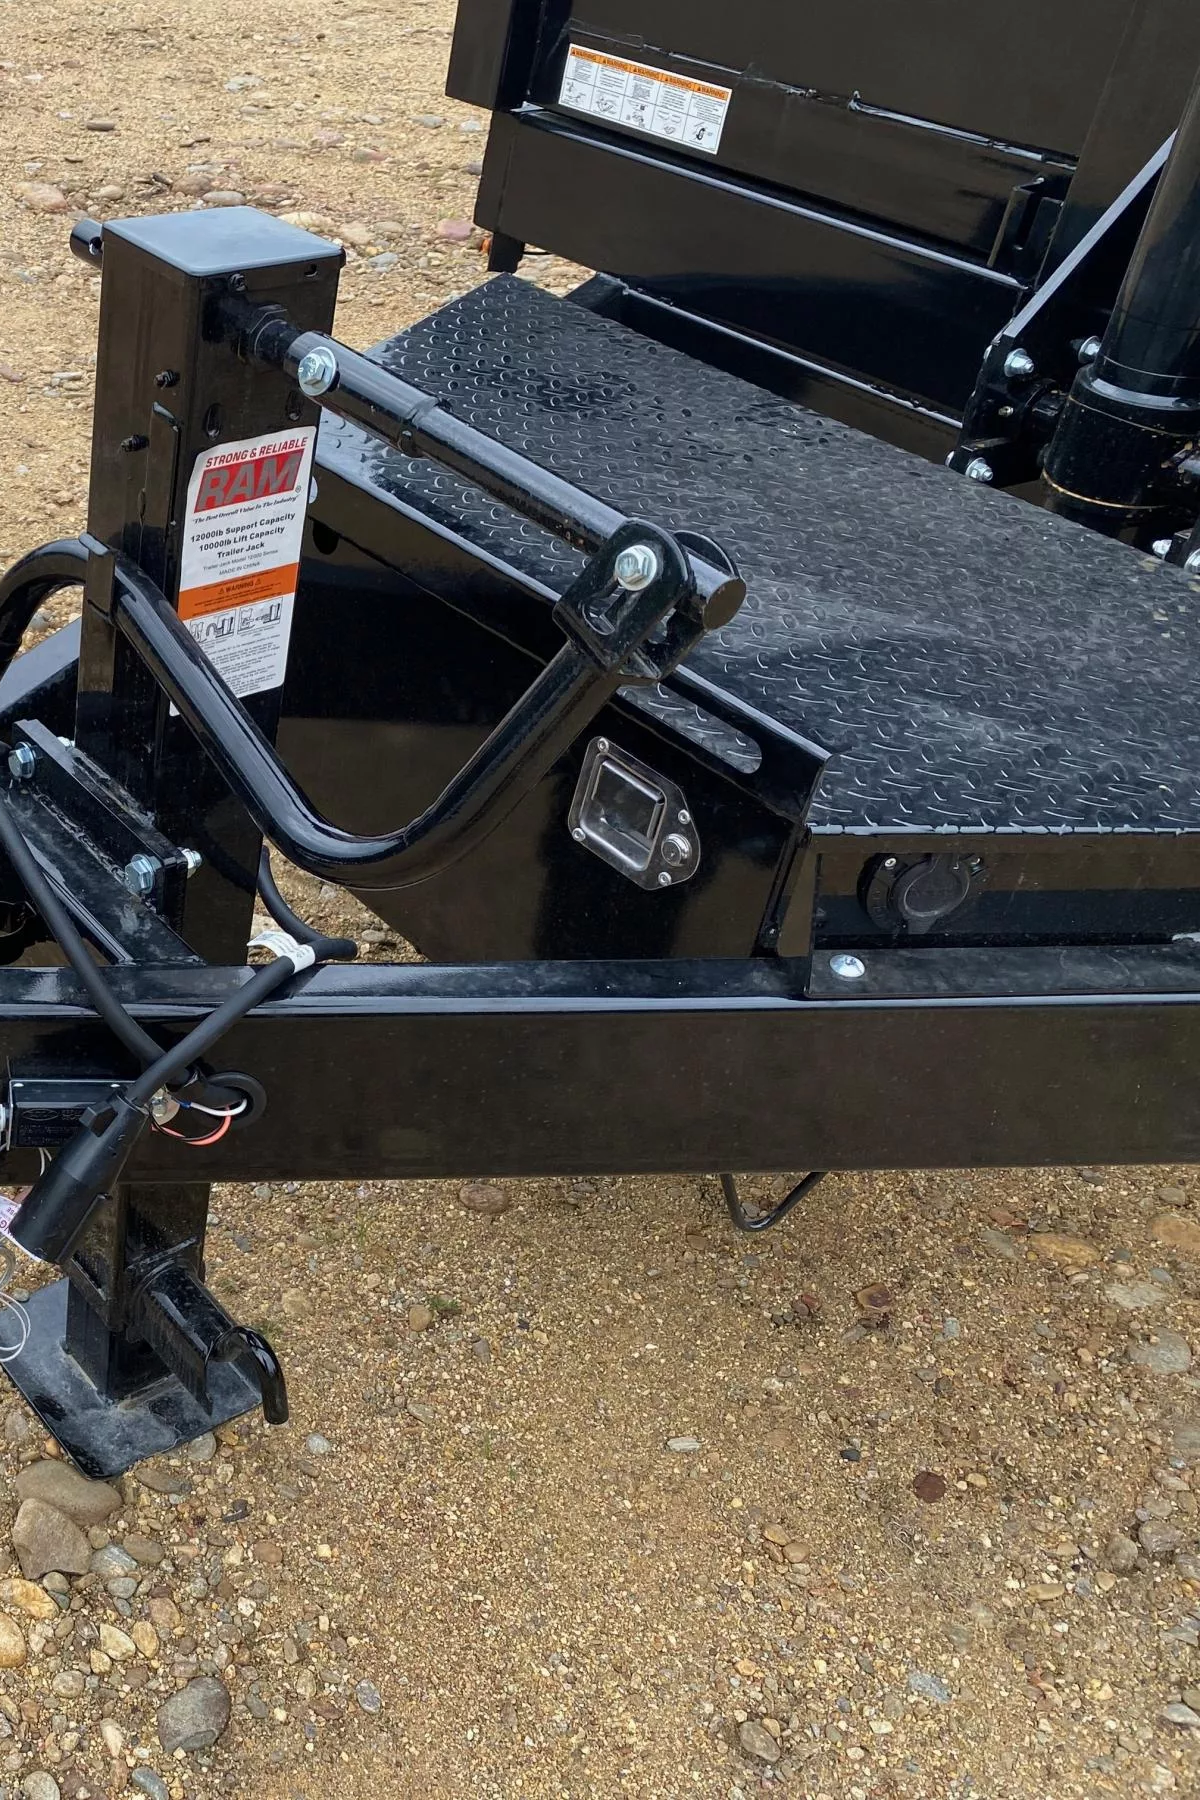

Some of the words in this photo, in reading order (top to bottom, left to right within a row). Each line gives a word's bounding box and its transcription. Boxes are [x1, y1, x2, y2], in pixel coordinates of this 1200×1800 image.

[206, 450, 249, 468] STRONG
[249, 447, 257, 458] &
[259, 437, 308, 457] RELIABLE
[197, 451, 303, 511] RAM
[262, 501, 273, 509] The
[190, 530, 224, 543] 12000lb
[225, 521, 258, 535] Support
[259, 513, 296, 526] Capacity
[199, 539, 232, 552] 10000lb
[233, 534, 248, 544] Lift
[249, 526, 285, 540] Capacity
[217, 547, 244, 559] Trailer
[245, 541, 265, 552] Jack
[219, 567, 236, 575] MADE
[243, 561, 260, 570] CHINA
[225, 580, 254, 593] WARNING
